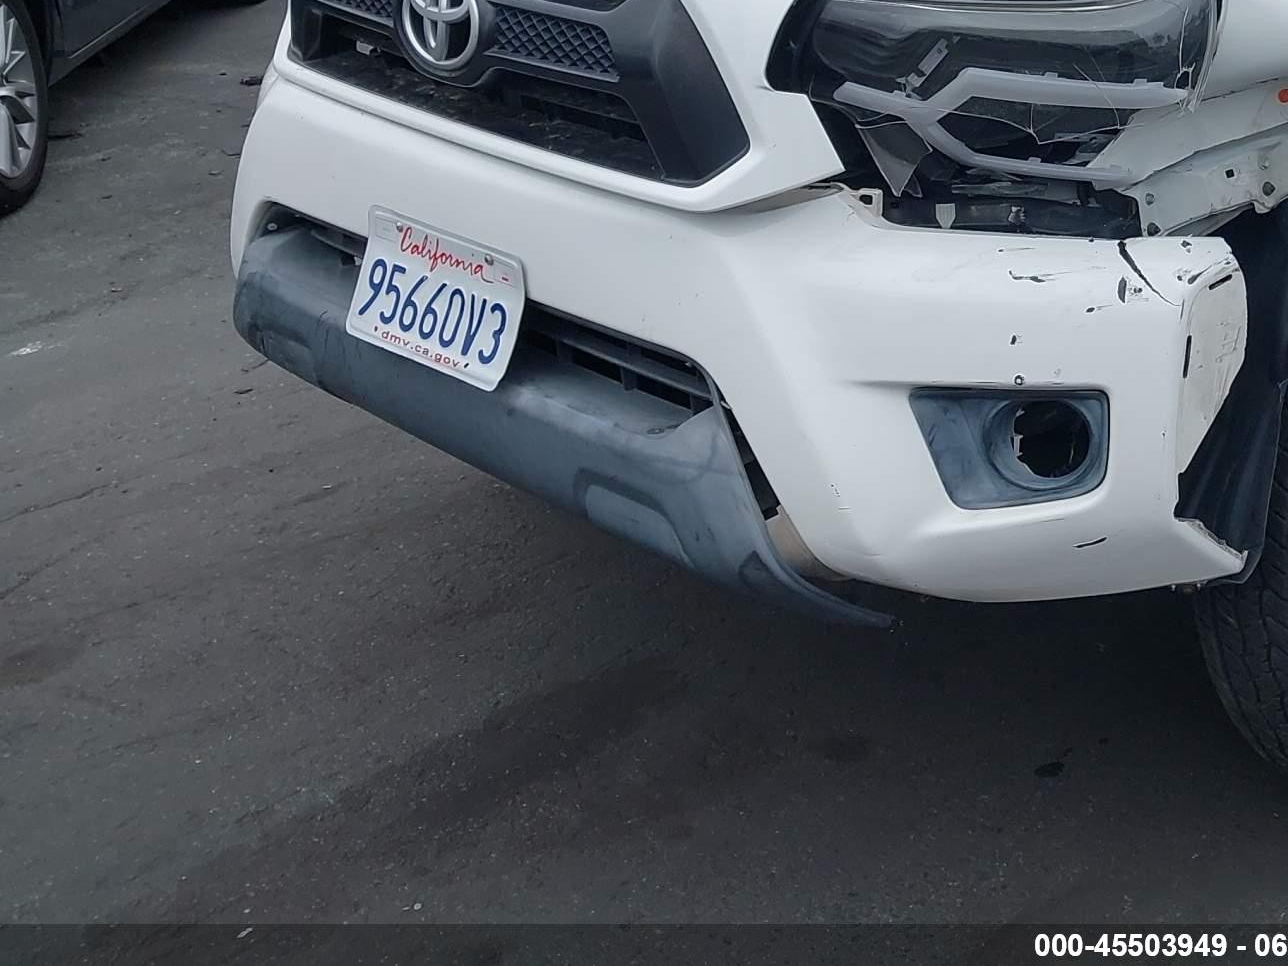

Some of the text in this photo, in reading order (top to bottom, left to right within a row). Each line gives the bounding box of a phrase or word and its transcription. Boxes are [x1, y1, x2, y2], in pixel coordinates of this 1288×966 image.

[399, 226, 494, 284] California
[357, 258, 508, 365] 95660V3
[381, 330, 460, 368] dmv.ca.gov
